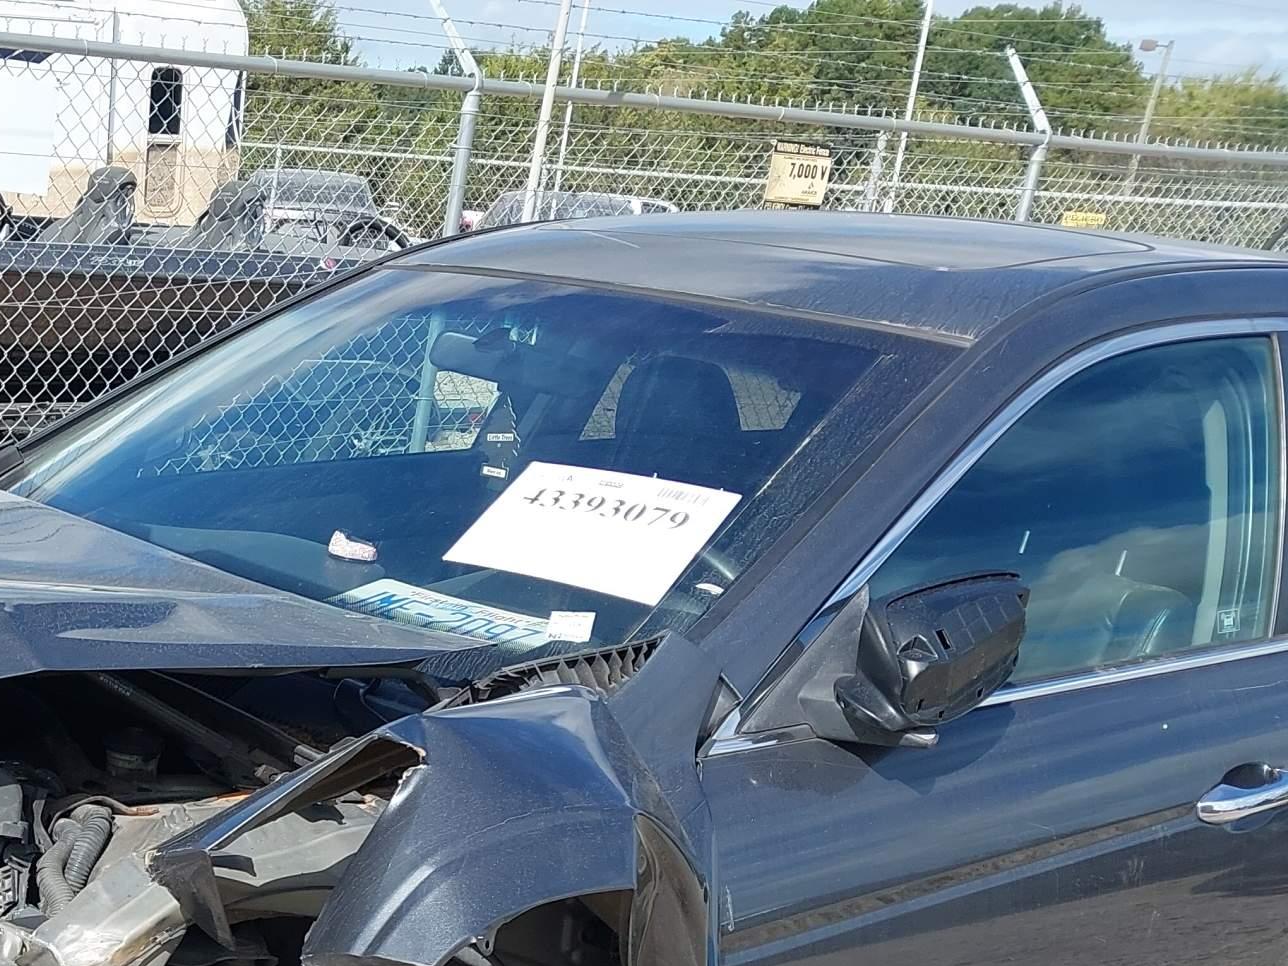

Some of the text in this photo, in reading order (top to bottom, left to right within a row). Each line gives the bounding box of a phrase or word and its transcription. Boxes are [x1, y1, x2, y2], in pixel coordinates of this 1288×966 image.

[789, 162, 828, 181] 7,000 V
[523, 488, 690, 530] 43393079
